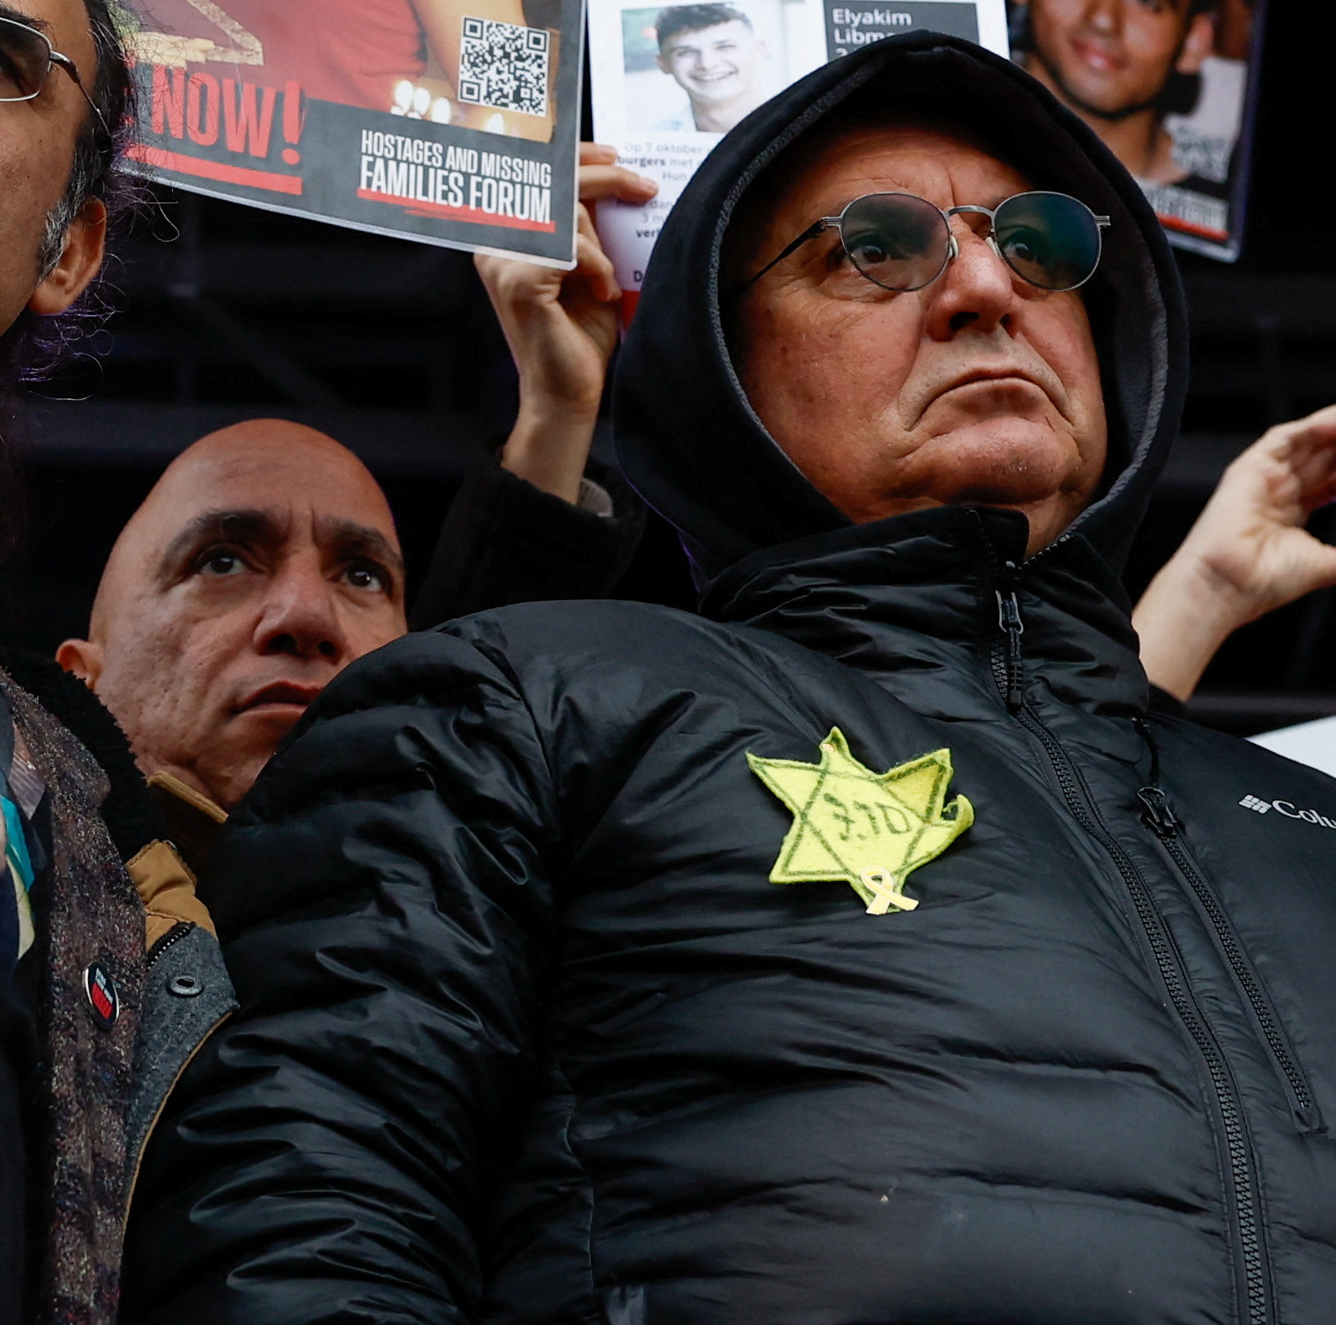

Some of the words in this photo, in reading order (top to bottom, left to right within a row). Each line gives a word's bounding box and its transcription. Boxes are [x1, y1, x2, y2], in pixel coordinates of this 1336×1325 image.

[832, 8, 912, 29] Elyakim
[150, 63, 301, 166] NOW!
[360, 155, 464, 208] FAMILIES
[468, 175, 551, 225] FORUM
[361, 128, 443, 168] HOSTAGES
[444, 145, 479, 174] AND
[480, 151, 552, 188] MISSING
